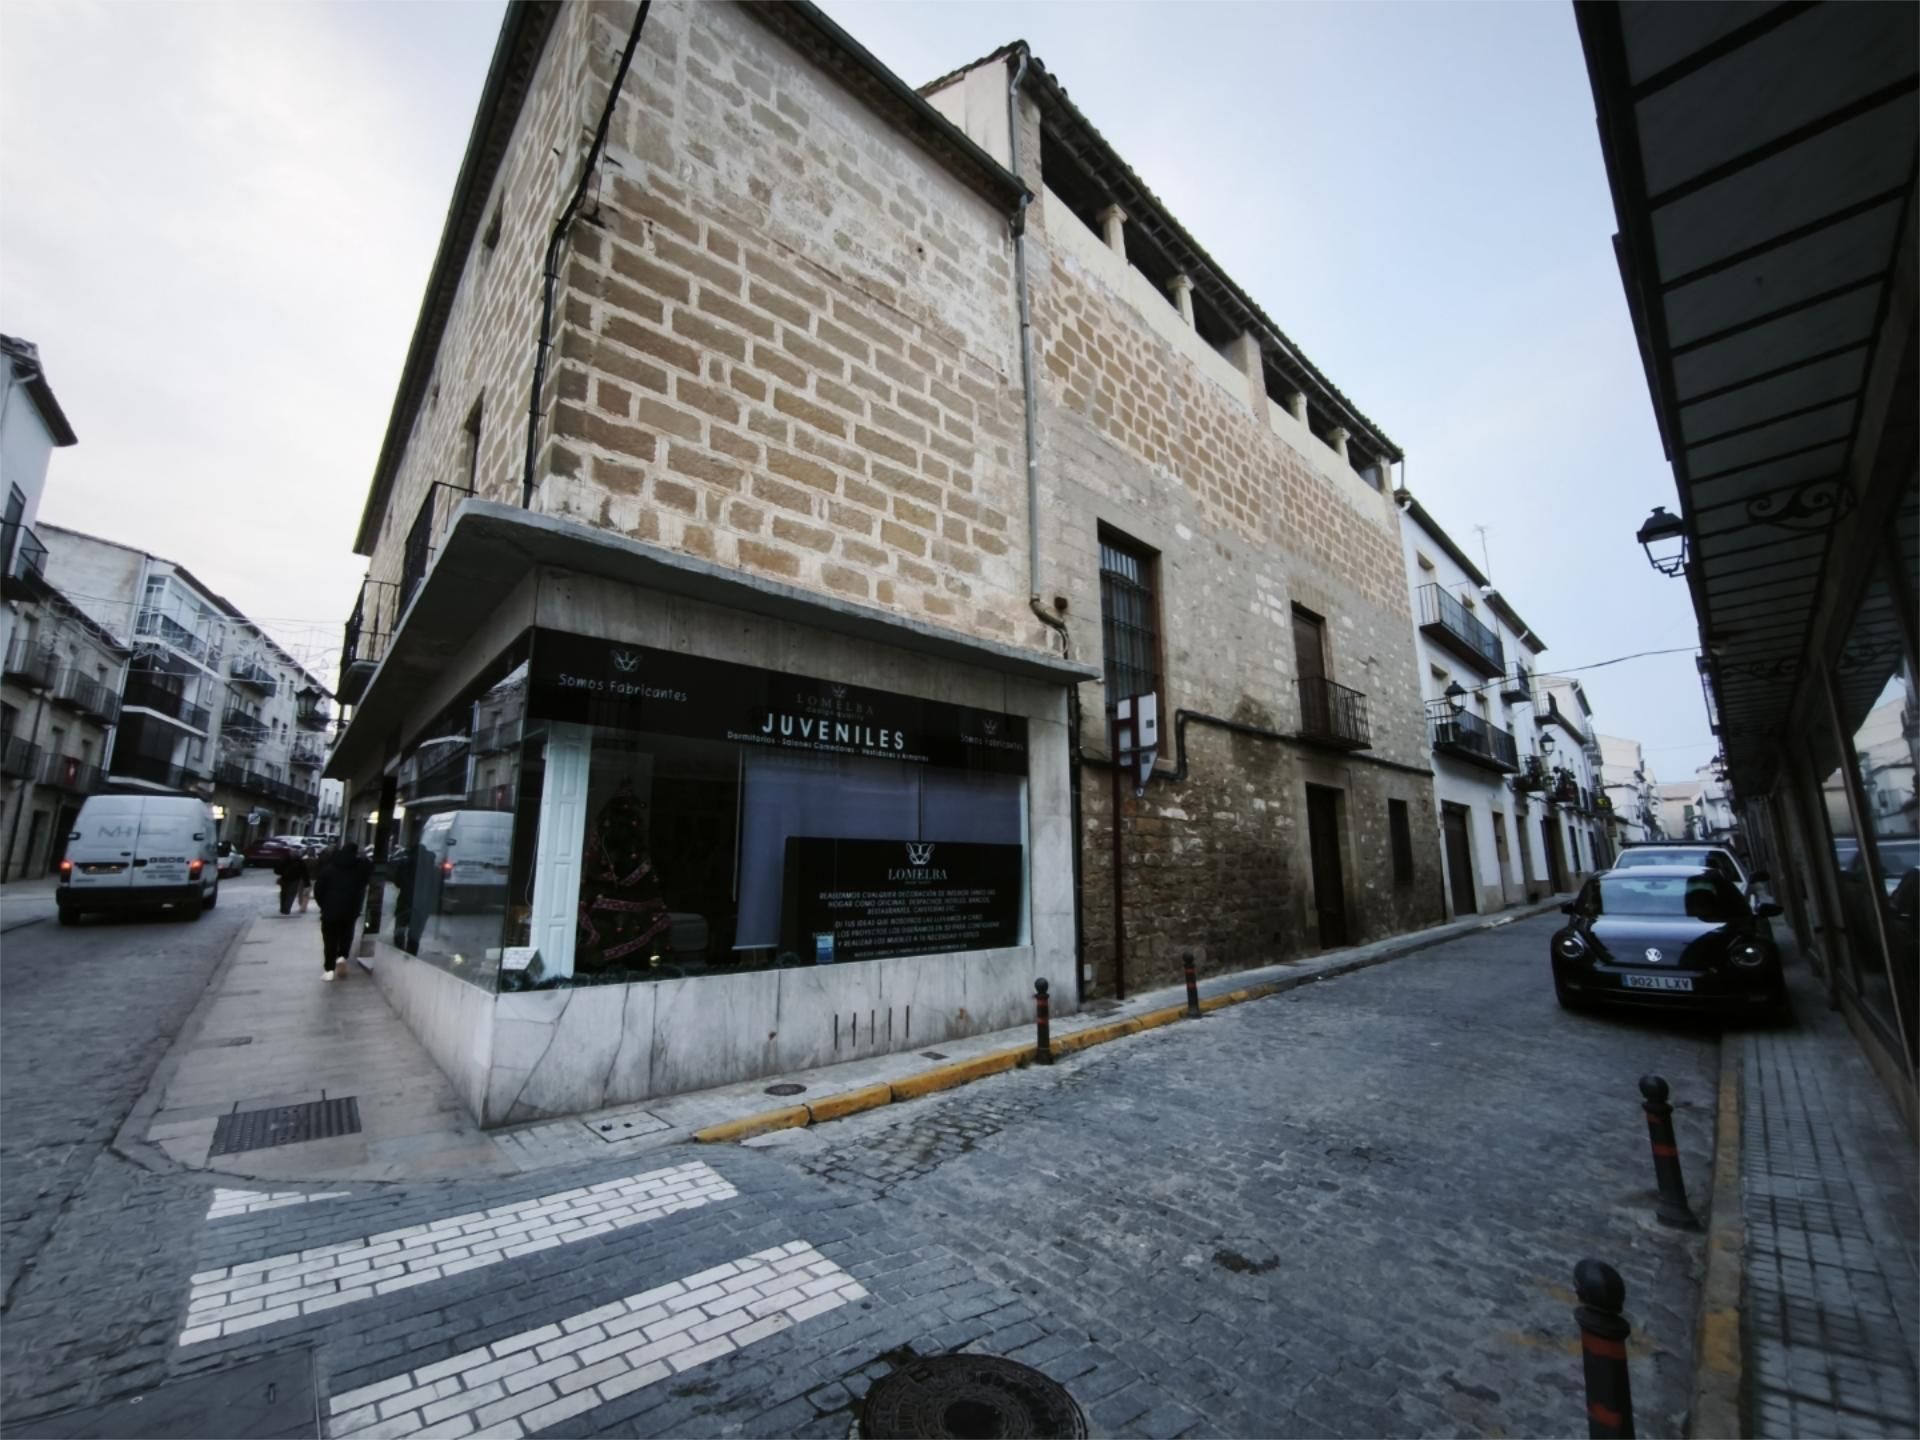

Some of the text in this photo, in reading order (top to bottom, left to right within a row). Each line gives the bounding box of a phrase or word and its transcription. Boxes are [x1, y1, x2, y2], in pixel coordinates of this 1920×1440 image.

[558, 673, 688, 702] Somos Fabricantes
[761, 712, 904, 751] JUVENILES
[1630, 976, 1660, 987] 9021
